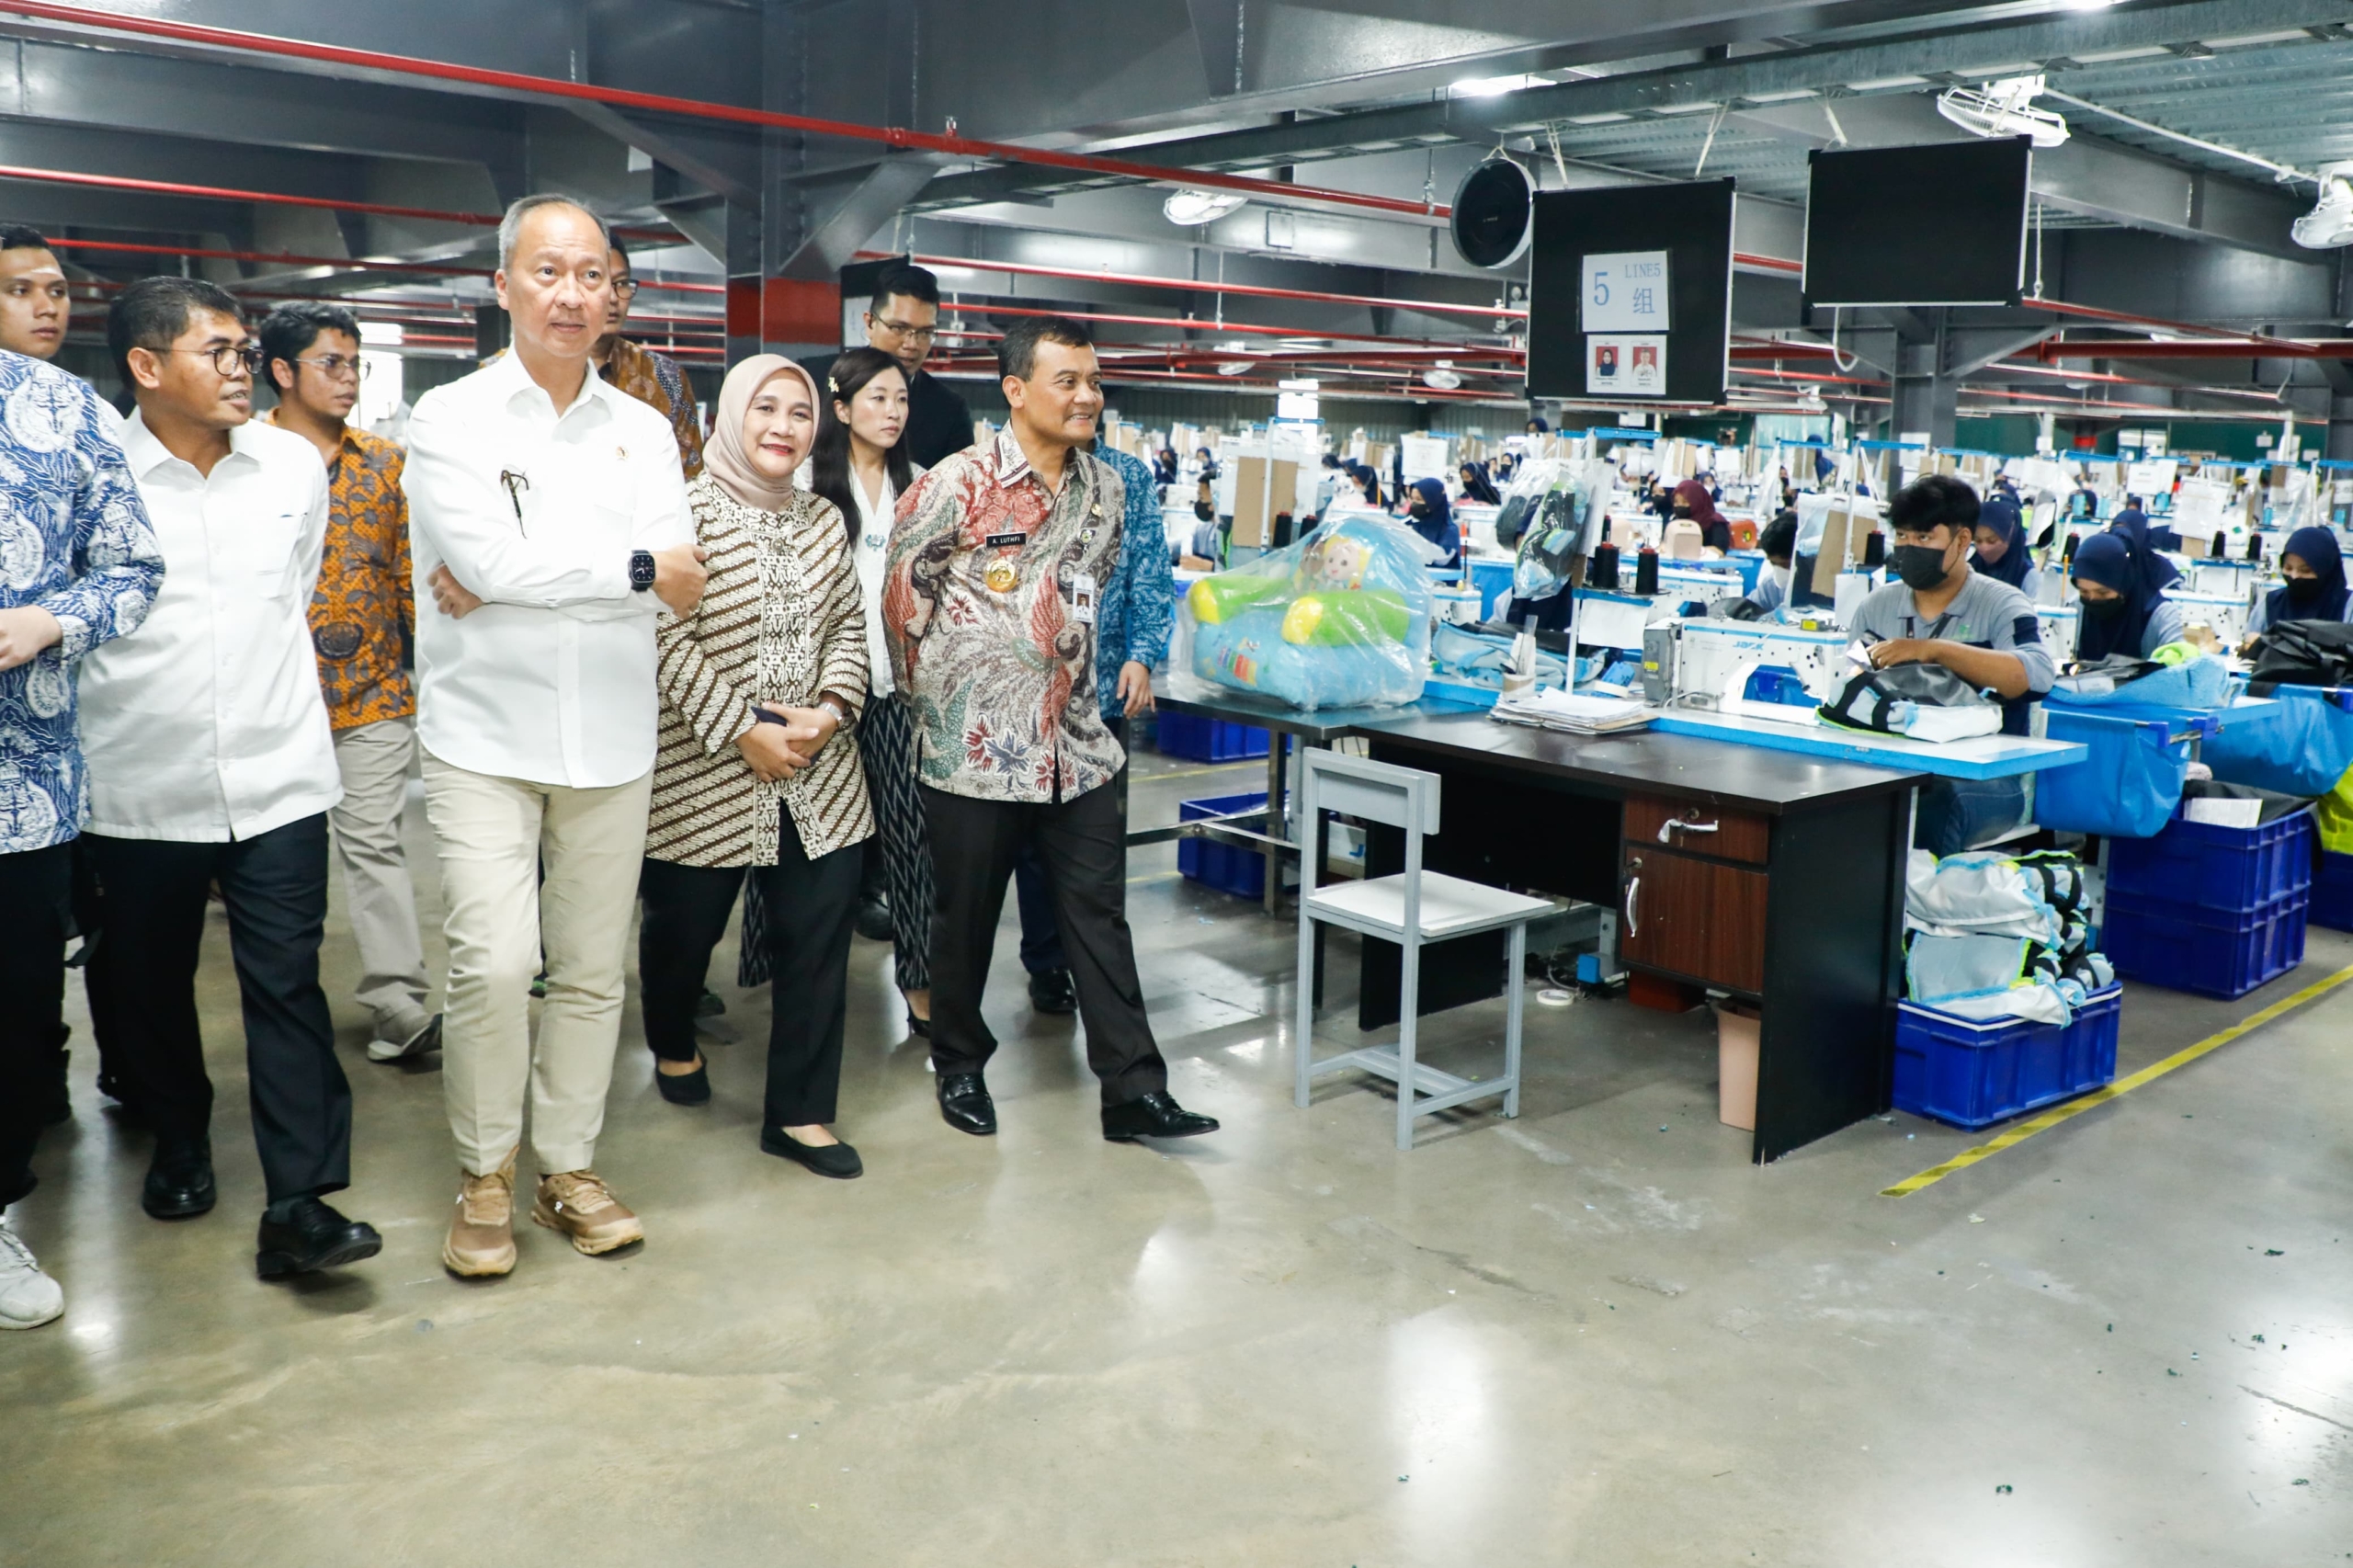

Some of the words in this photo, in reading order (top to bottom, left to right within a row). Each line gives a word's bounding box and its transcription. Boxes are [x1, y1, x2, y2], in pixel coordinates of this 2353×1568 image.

[1624, 263, 1661, 278] LINE5
[1594, 271, 1610, 306] 5
[1632, 287, 1656, 314] 组
[1000, 536, 1020, 544] LUTHFI
